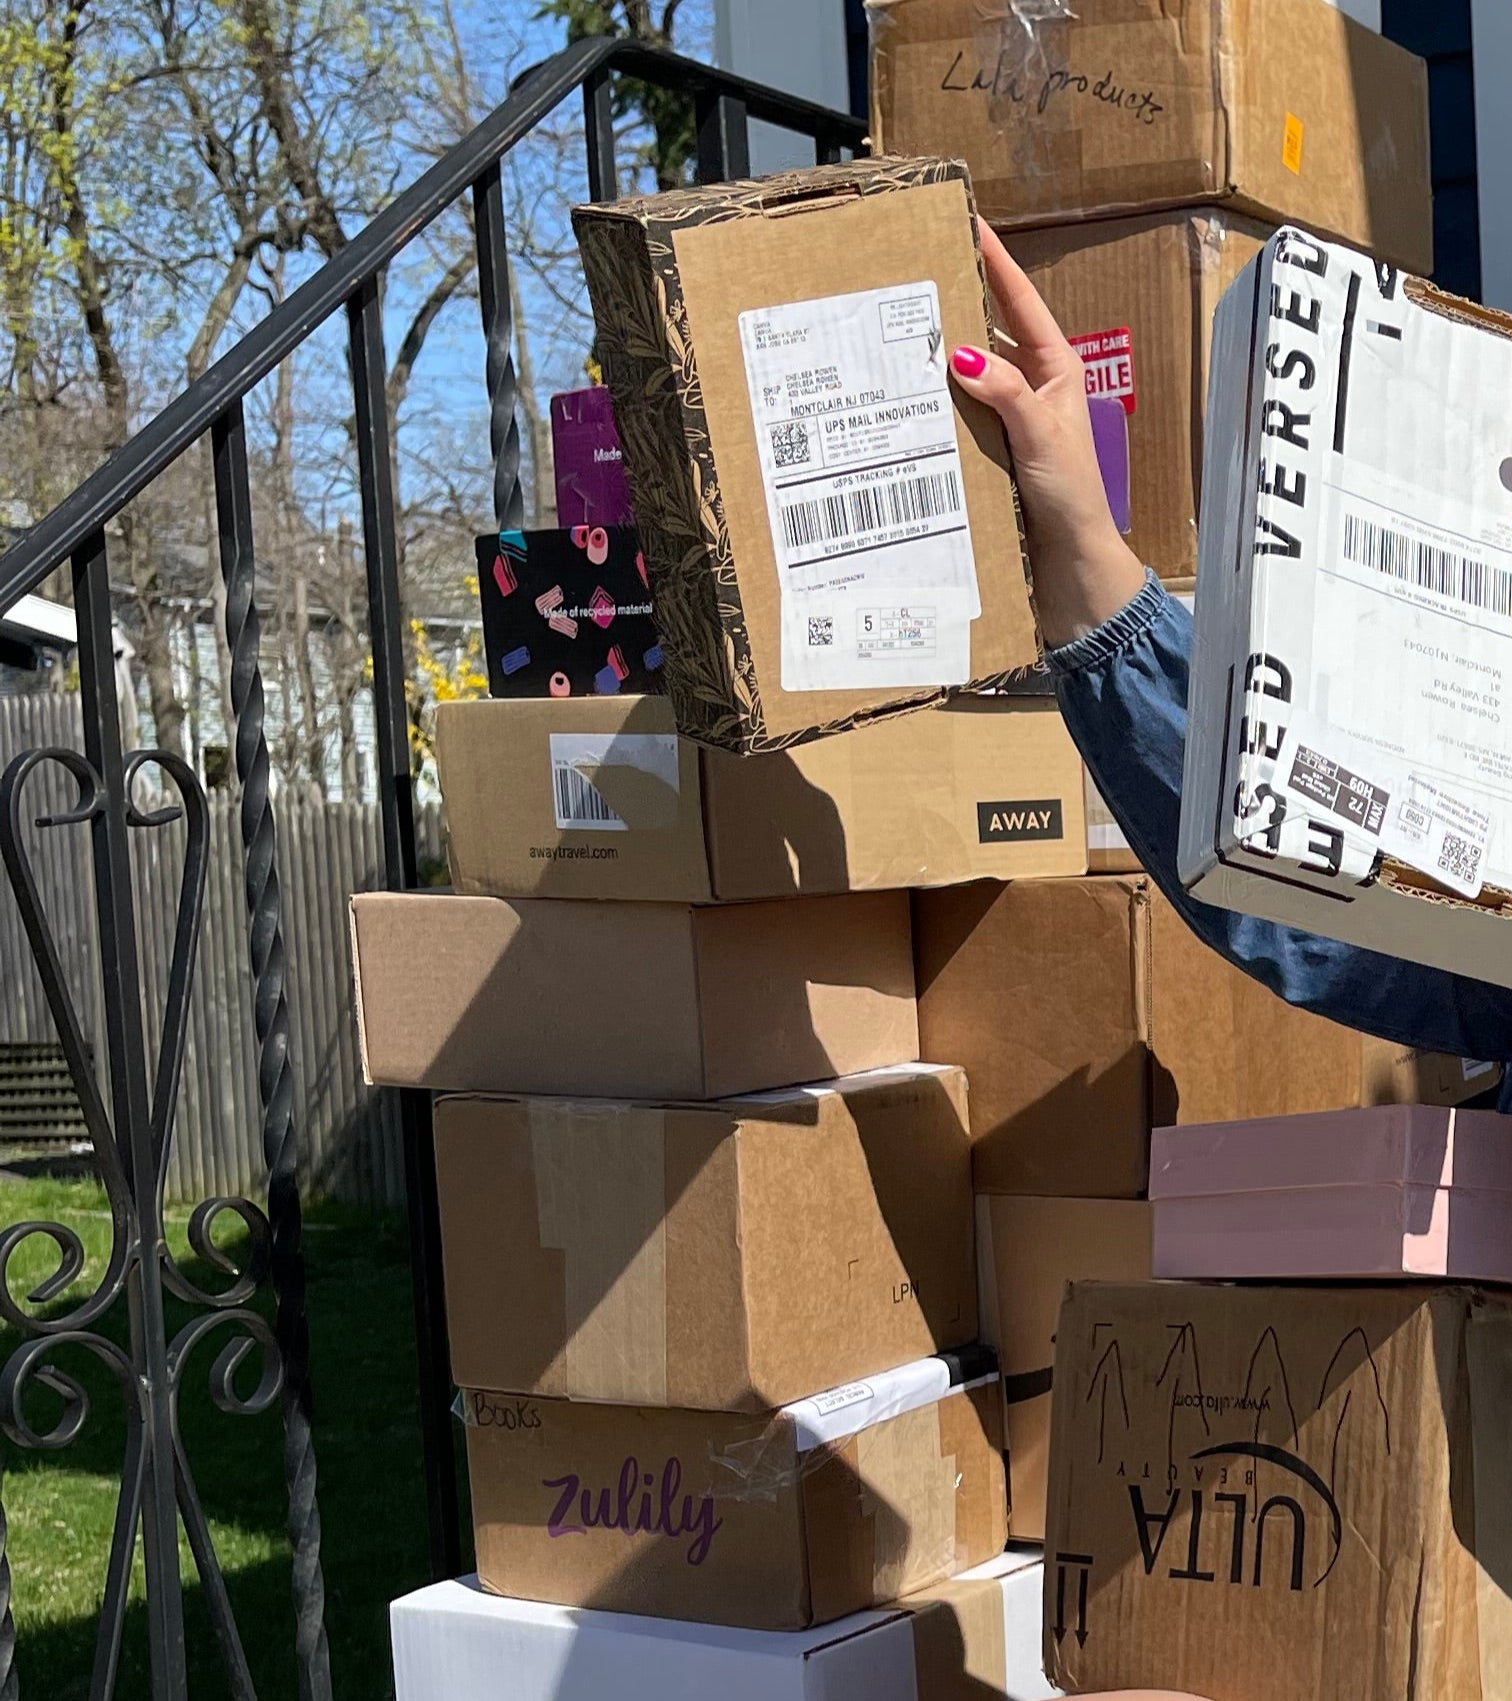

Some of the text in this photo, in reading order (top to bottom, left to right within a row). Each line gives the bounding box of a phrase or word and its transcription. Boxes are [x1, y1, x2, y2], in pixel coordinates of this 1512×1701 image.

[1038, 70, 1163, 125] products
[1101, 334, 1129, 352] CARE
[1085, 362, 1131, 395] GILE
[791, 389, 886, 417] MONTCLAIR NJ 07043
[1253, 231, 1328, 559] VERSED
[825, 400, 940, 434] UPS MAIL INNOVATIONS
[593, 447, 622, 463] Made
[832, 476, 853, 489] USPS
[855, 468, 894, 483] TRACKING
[543, 602, 653, 619] Made of recycled material
[864, 615, 873, 632] 5
[1421, 689, 1501, 723] Chelsea Rowen
[1348, 796, 1364, 815] 72
[989, 810, 1051, 832] AWAY
[529, 844, 618, 861] awaytravel.com
[892, 1280, 920, 1304] LPN
[1174, 1392, 1271, 1416] www.ulta.com
[1116, 1461, 1254, 1484] BEAUTY
[1128, 1485, 1305, 1591] ULTA
